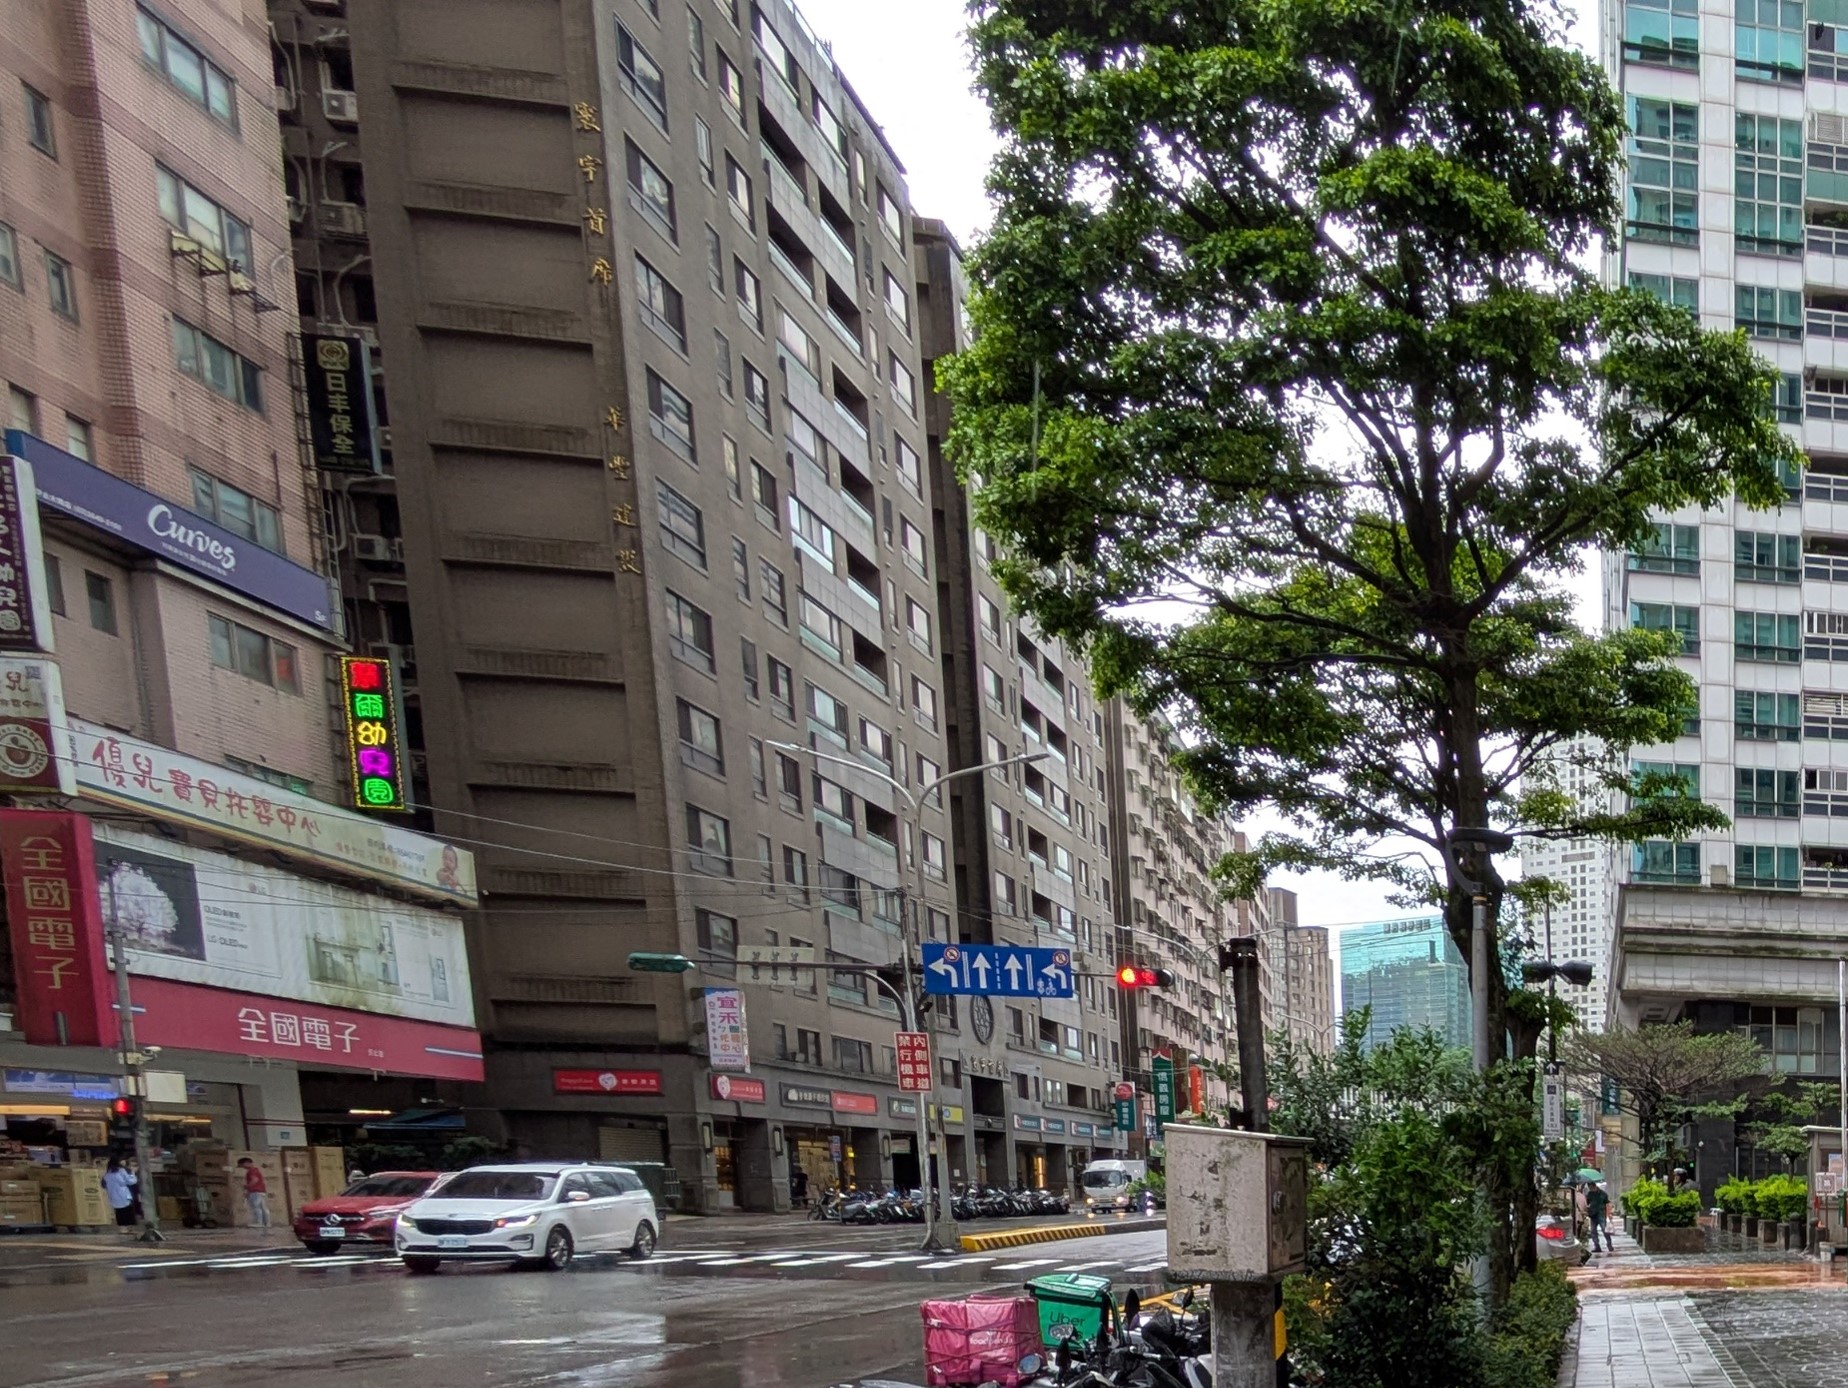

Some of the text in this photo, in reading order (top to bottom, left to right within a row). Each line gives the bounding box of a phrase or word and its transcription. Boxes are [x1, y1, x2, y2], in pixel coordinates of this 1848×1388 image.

[147, 503, 236, 571] Curves
[20, 836, 80, 990] 全國電子
[238, 1007, 361, 1053] 全國電子
[898, 1035, 914, 1088] 禁行機車
[913, 1035, 930, 1089] 內側車道
[1050, 1311, 1086, 1326] Uber
